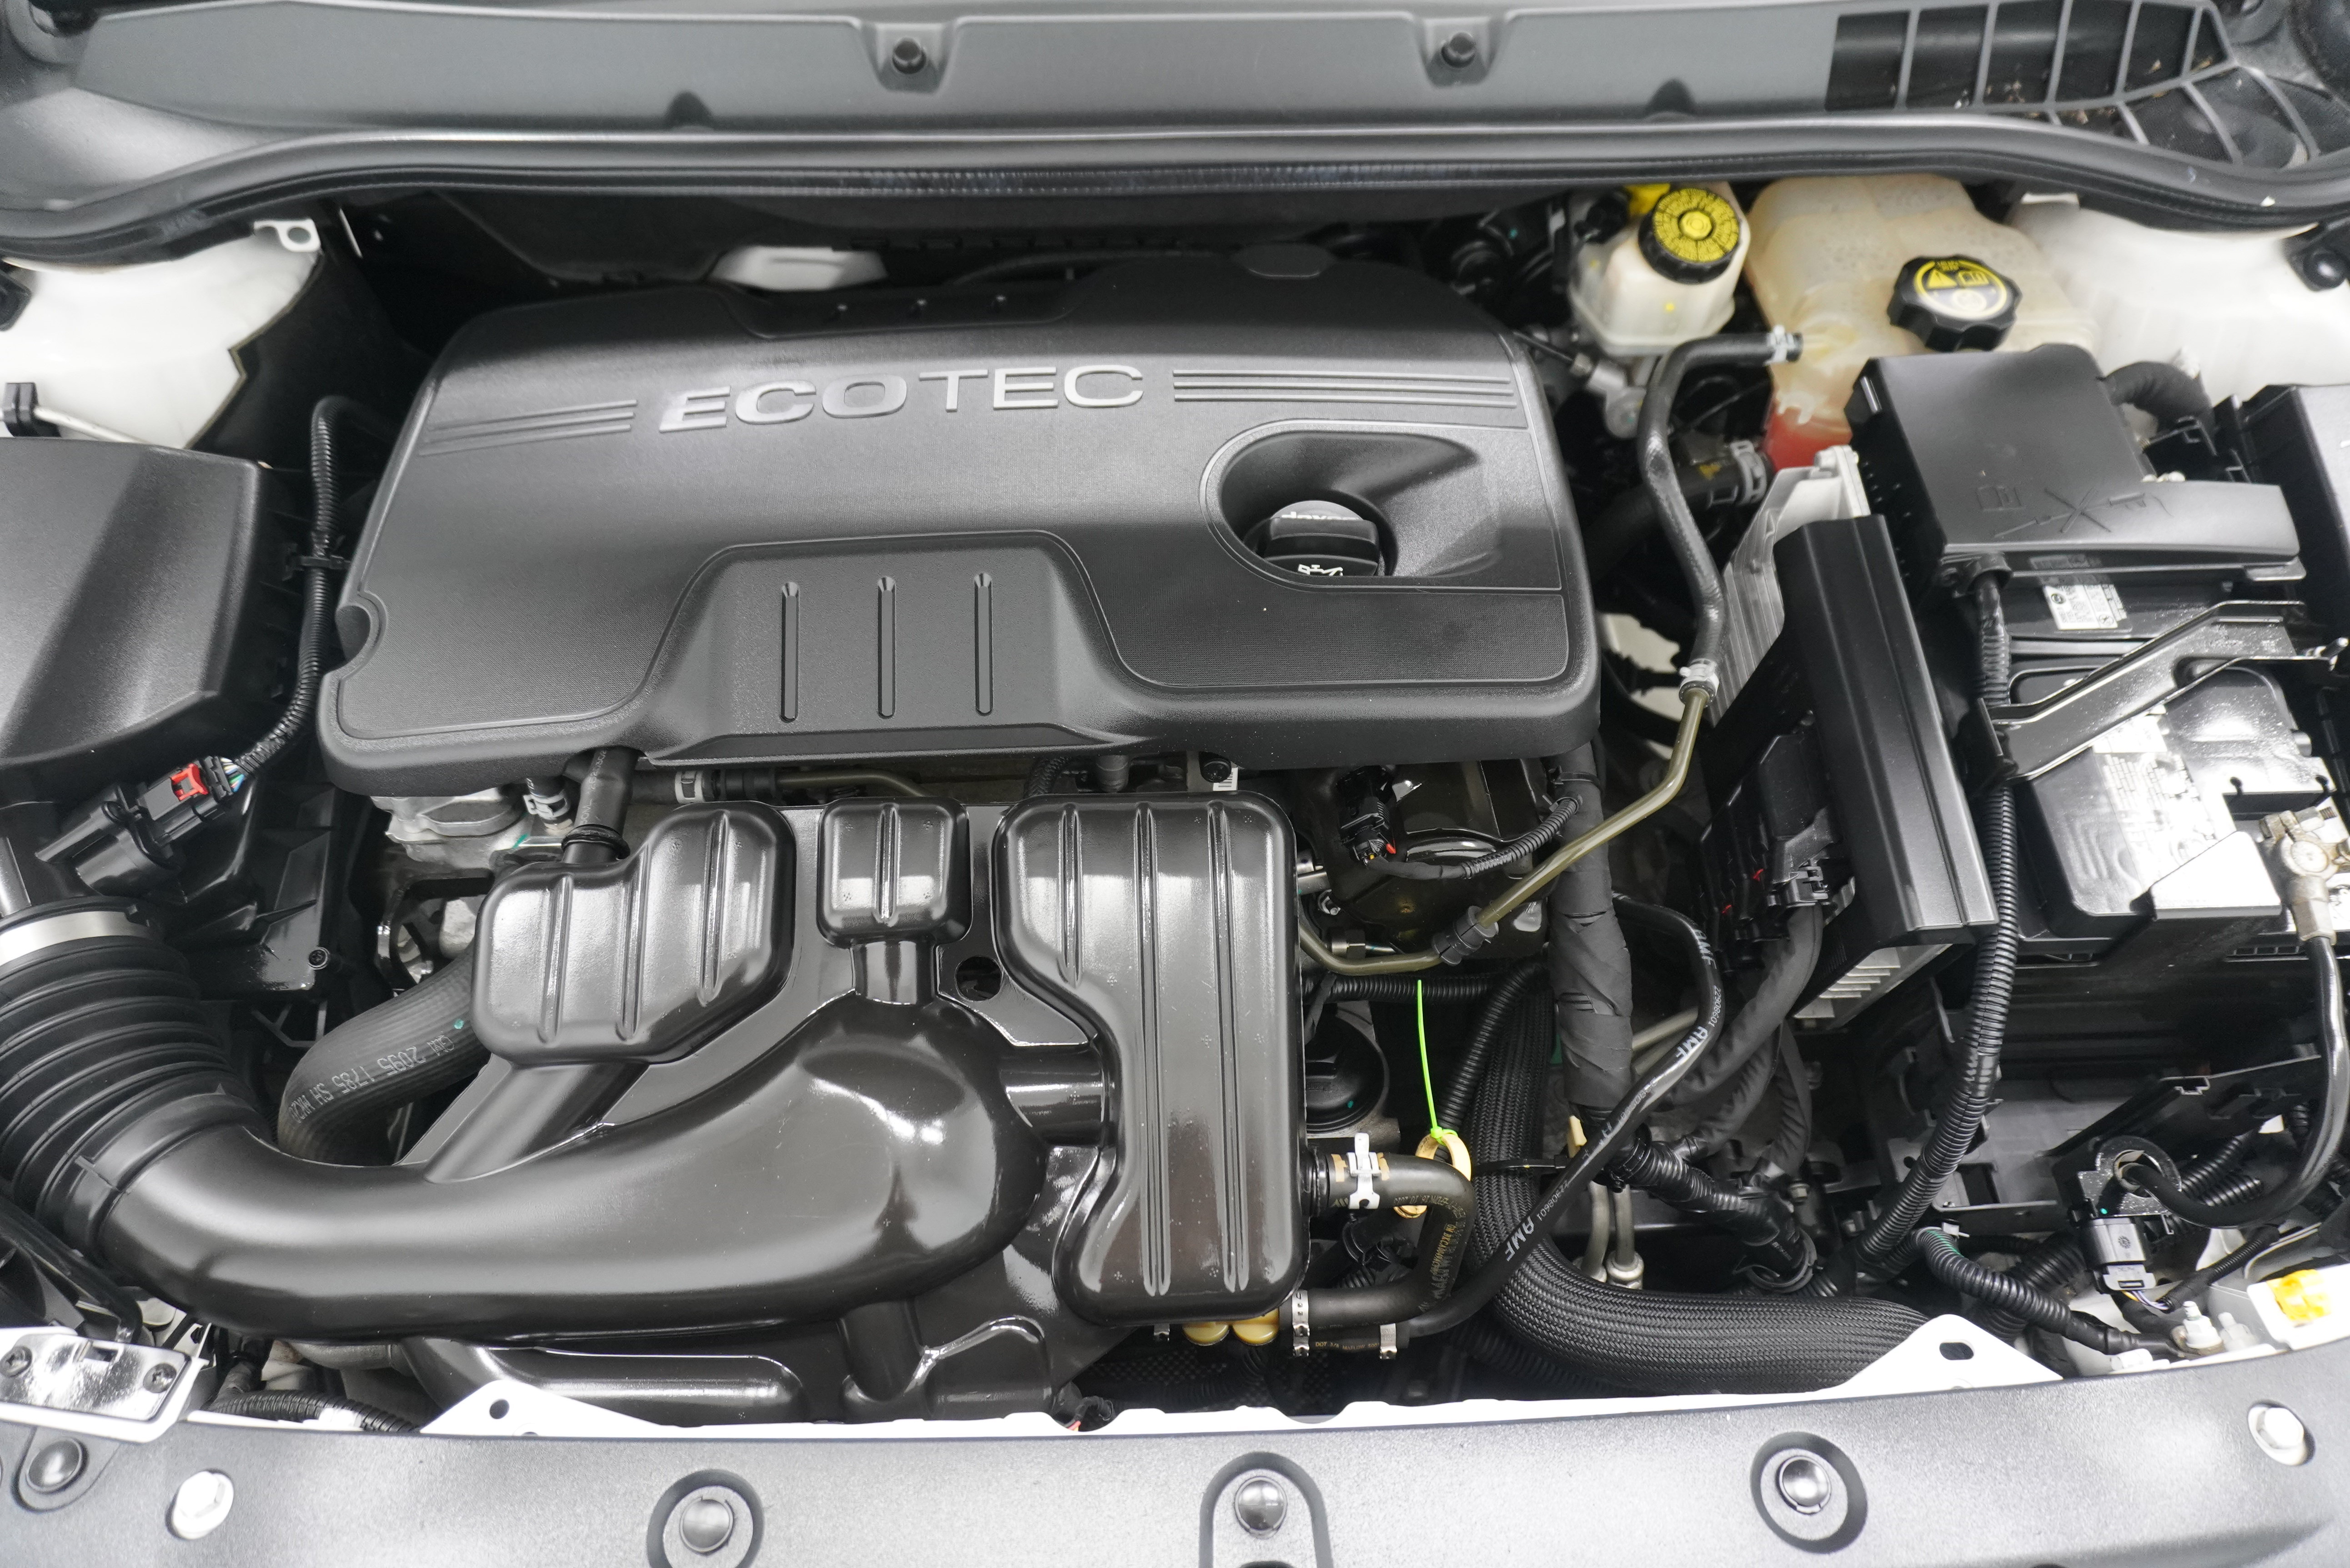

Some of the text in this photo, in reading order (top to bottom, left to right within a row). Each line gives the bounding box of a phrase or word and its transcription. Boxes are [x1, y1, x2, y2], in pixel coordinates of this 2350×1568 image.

[659, 365, 1144, 434] ECOTEC
[1694, 929, 1717, 970] AMF
[1708, 985, 1722, 1028] 22908601
[1675, 1025, 1708, 1059] AMF
[377, 1046, 427, 1076] 2095
[310, 1083, 335, 1106] SH
[331, 1066, 375, 1094] 1785
[1504, 1216, 1535, 1262] AMF
